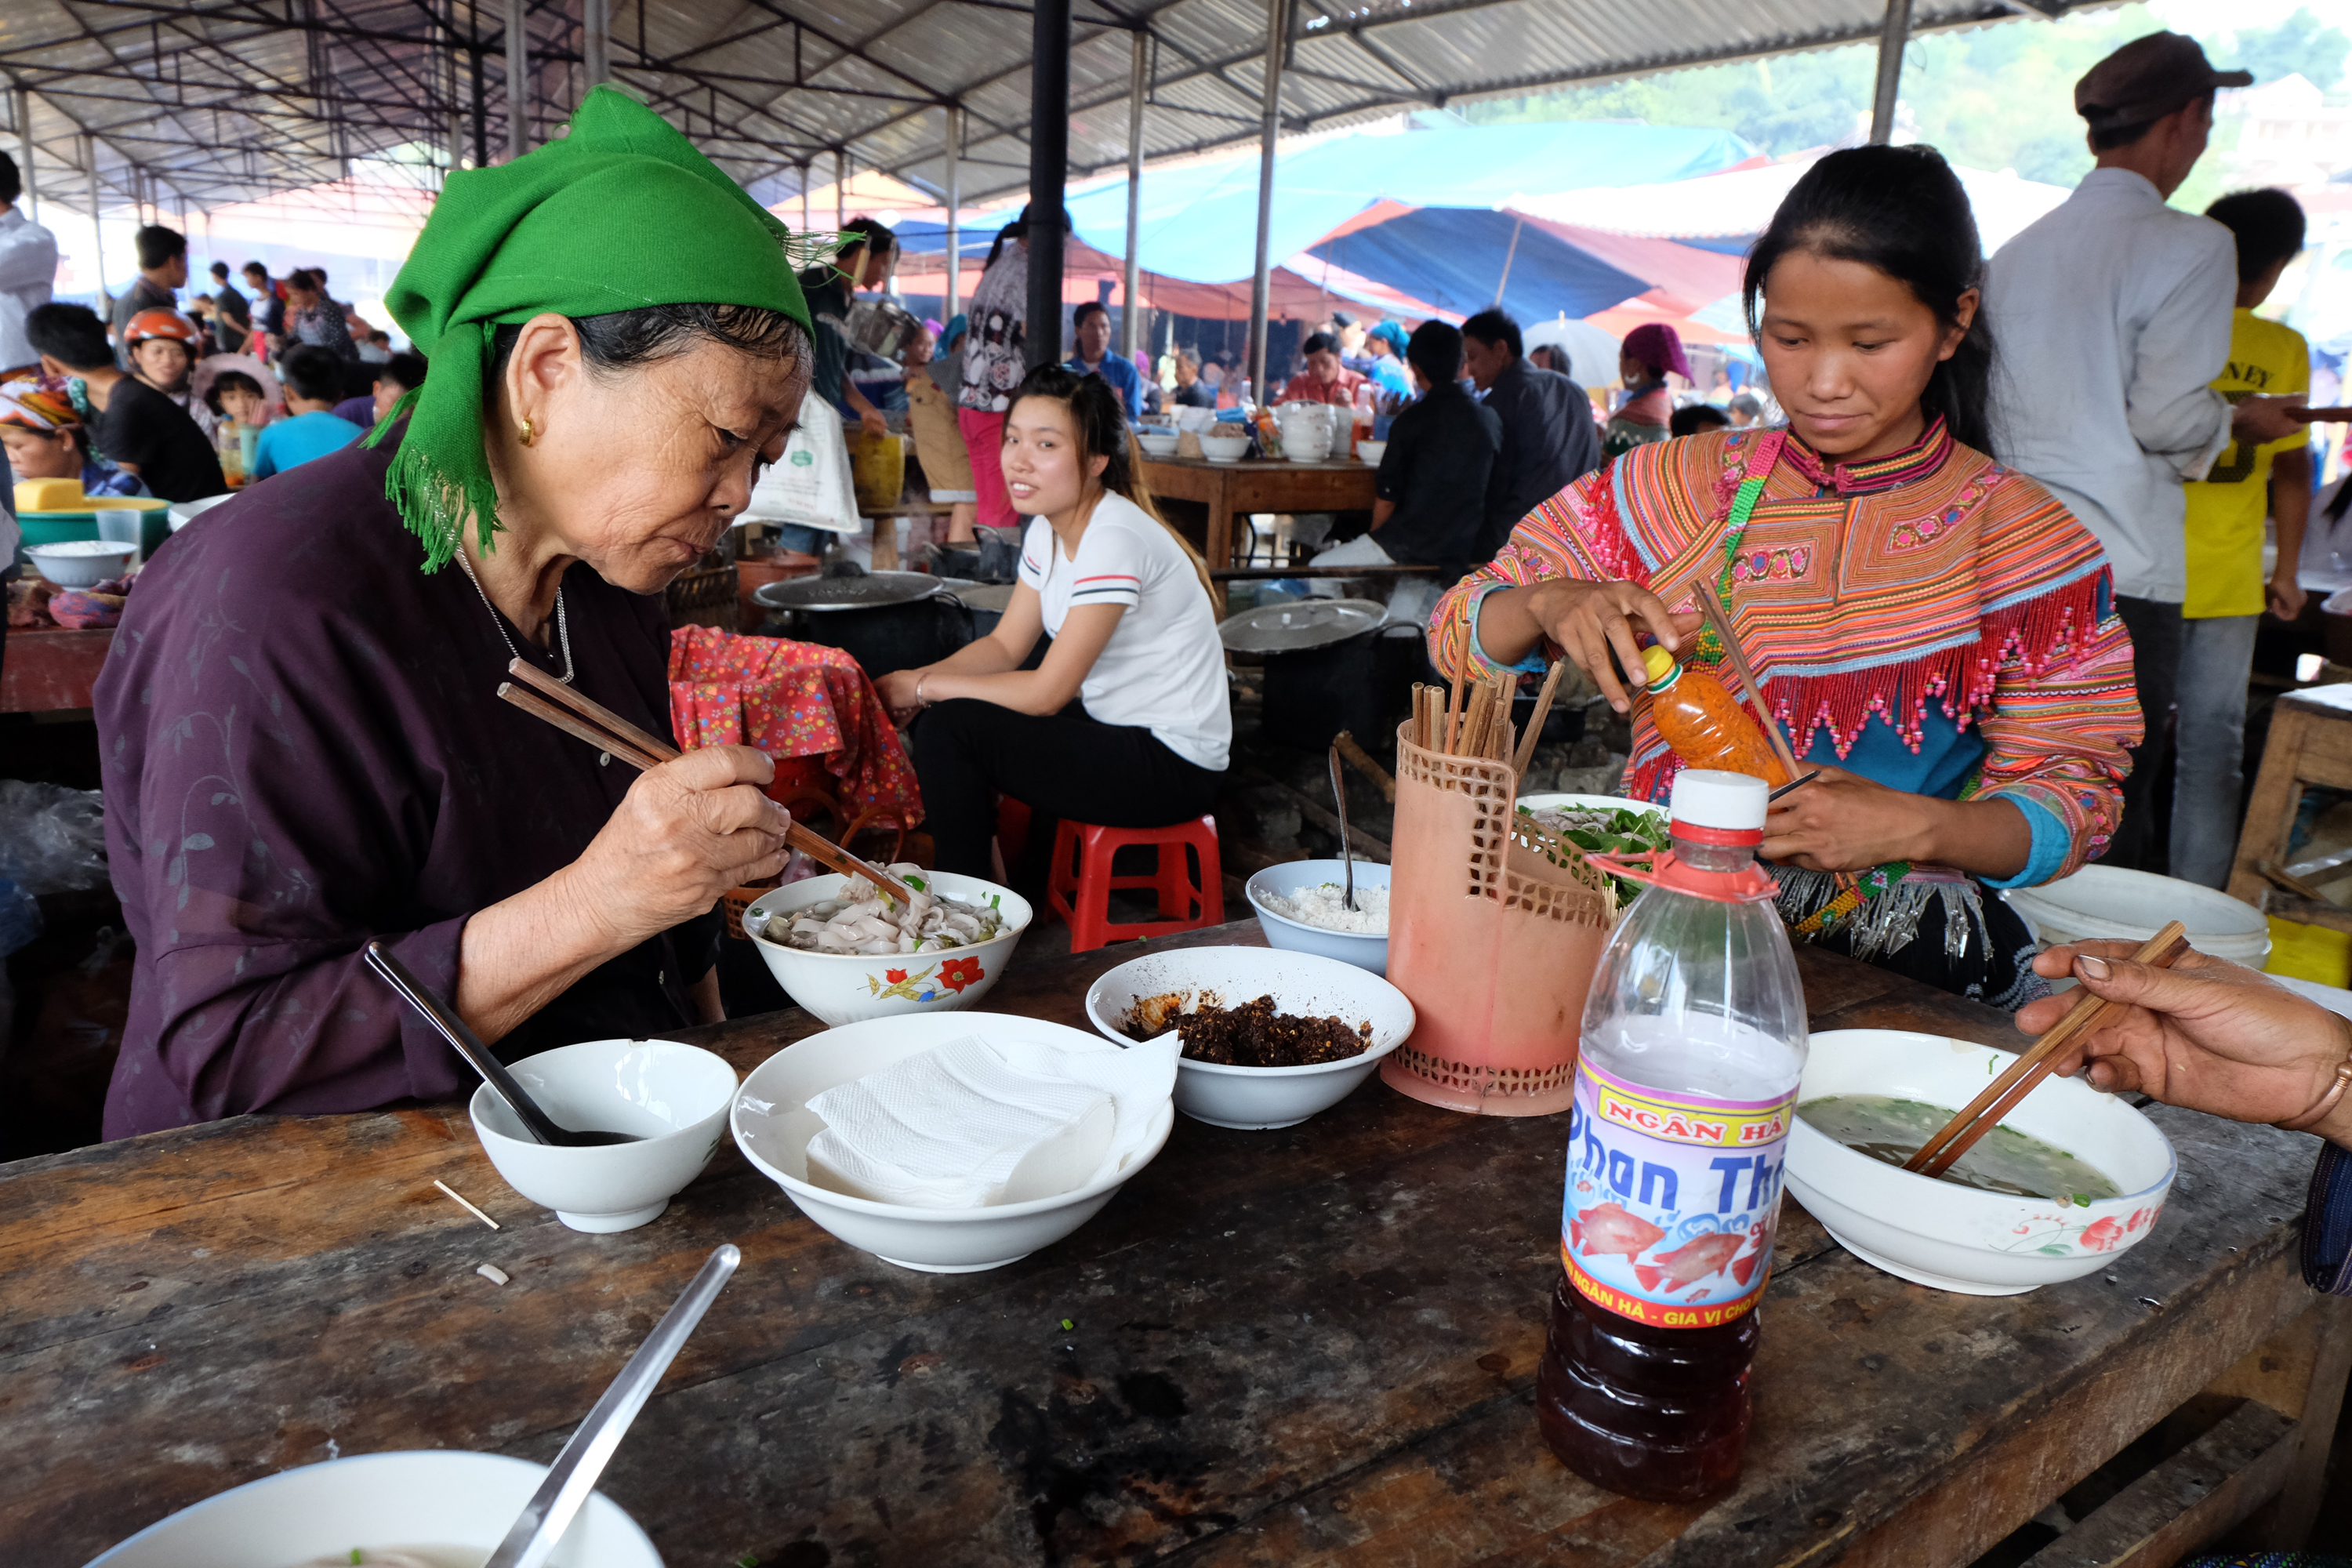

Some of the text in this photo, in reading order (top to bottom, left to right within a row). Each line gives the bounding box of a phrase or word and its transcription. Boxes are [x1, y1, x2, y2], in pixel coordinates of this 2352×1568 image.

[1608, 1100, 1784, 1142] NGÂN HÀ
[1573, 1269, 1614, 1307] NGÂN
[1617, 1298, 1646, 1320] HÀ
[1663, 1311, 1699, 1326] GIA
[1704, 1309, 1722, 1327] VỊ
[1724, 1299, 1751, 1320] CHO
